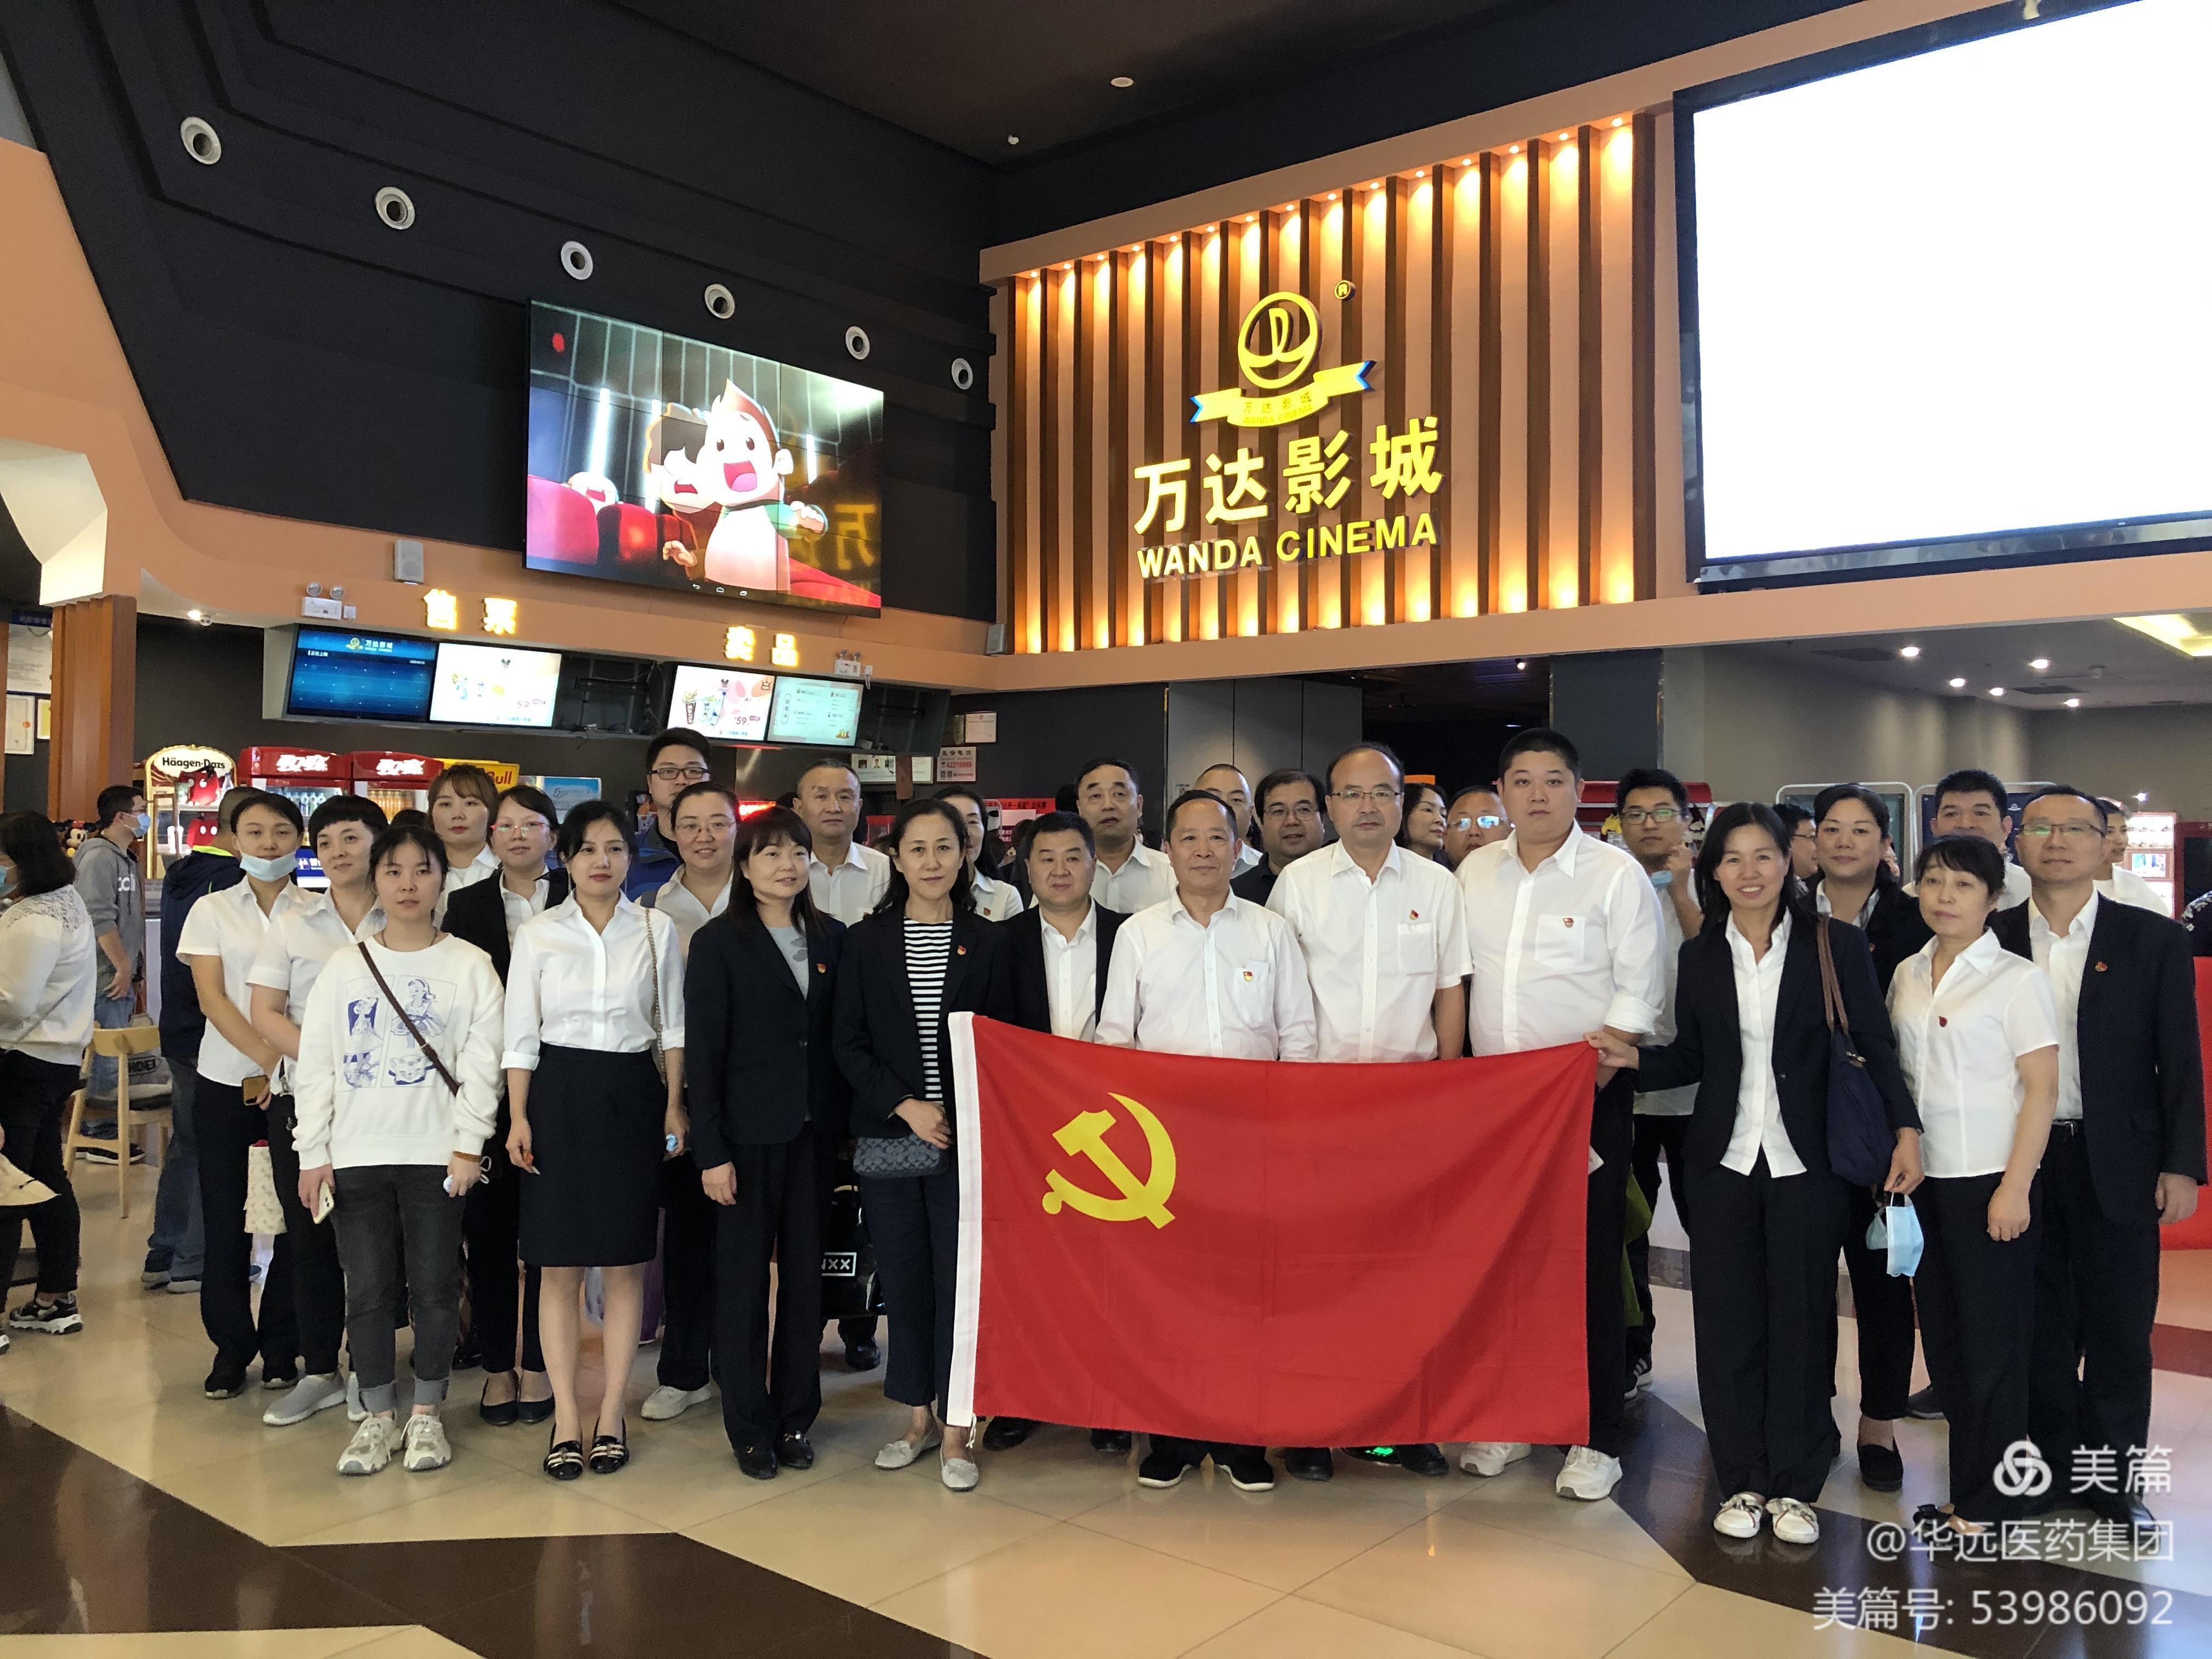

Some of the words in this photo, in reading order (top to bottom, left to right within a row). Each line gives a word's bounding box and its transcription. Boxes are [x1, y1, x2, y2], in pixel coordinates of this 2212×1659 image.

[1134, 416, 1443, 534] 万达影城
[1137, 535, 1262, 578] WANDA
[1277, 512, 1437, 562] CINEMA
[162, 757, 225, 769] Häagen-Dazs
